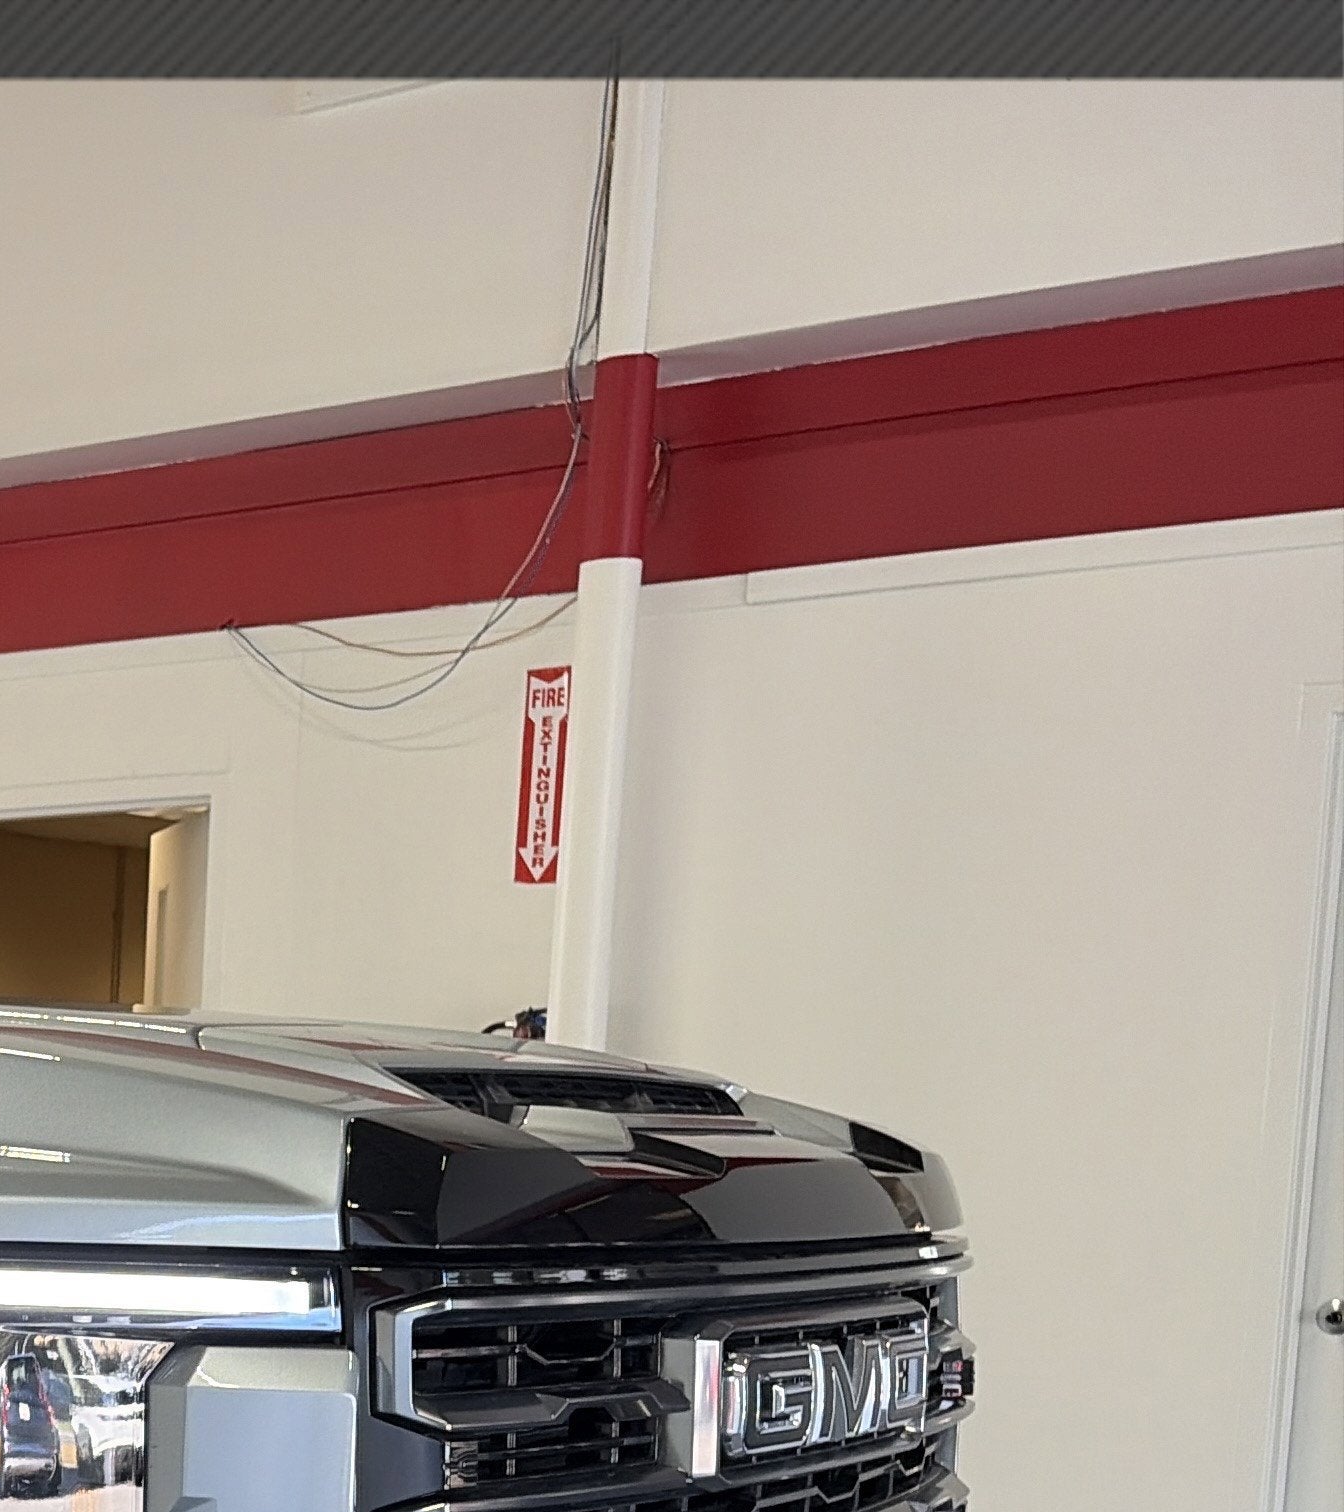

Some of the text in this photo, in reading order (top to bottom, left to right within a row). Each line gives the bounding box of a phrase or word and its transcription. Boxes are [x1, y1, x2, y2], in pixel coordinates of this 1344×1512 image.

[531, 687, 565, 709] FIRE
[531, 715, 554, 868] EXTINGUISHER
[723, 1334, 929, 1457] GMC
